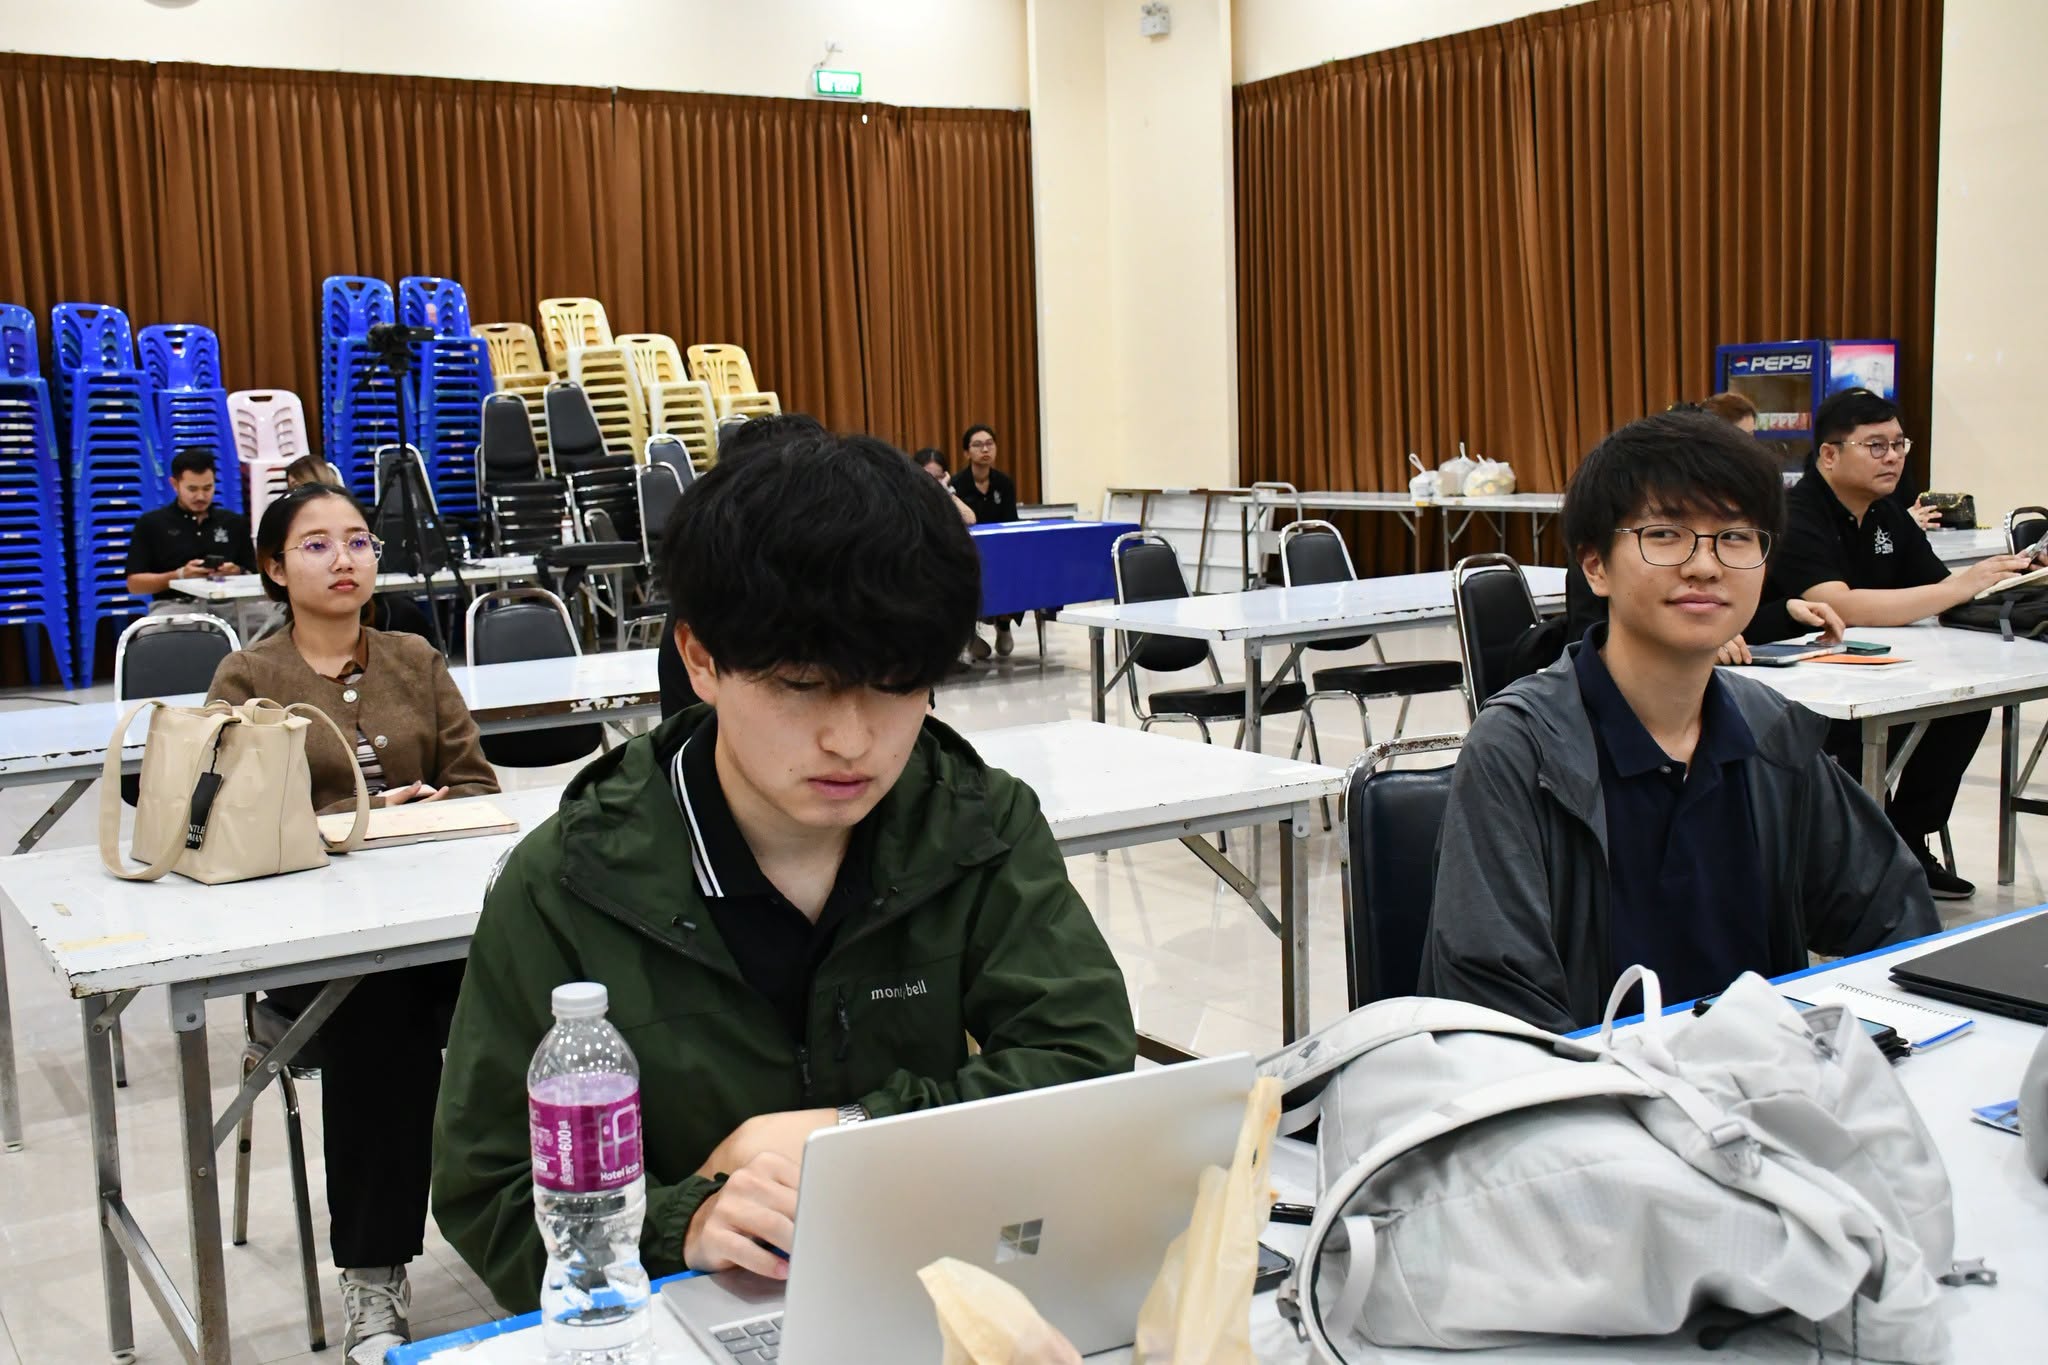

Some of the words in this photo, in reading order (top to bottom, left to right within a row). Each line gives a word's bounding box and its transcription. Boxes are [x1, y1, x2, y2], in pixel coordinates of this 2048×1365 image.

[1751, 355, 1812, 371] PEPSI
[557, 1130, 572, 1151] 600
[600, 1168, 625, 1181] Hotel
